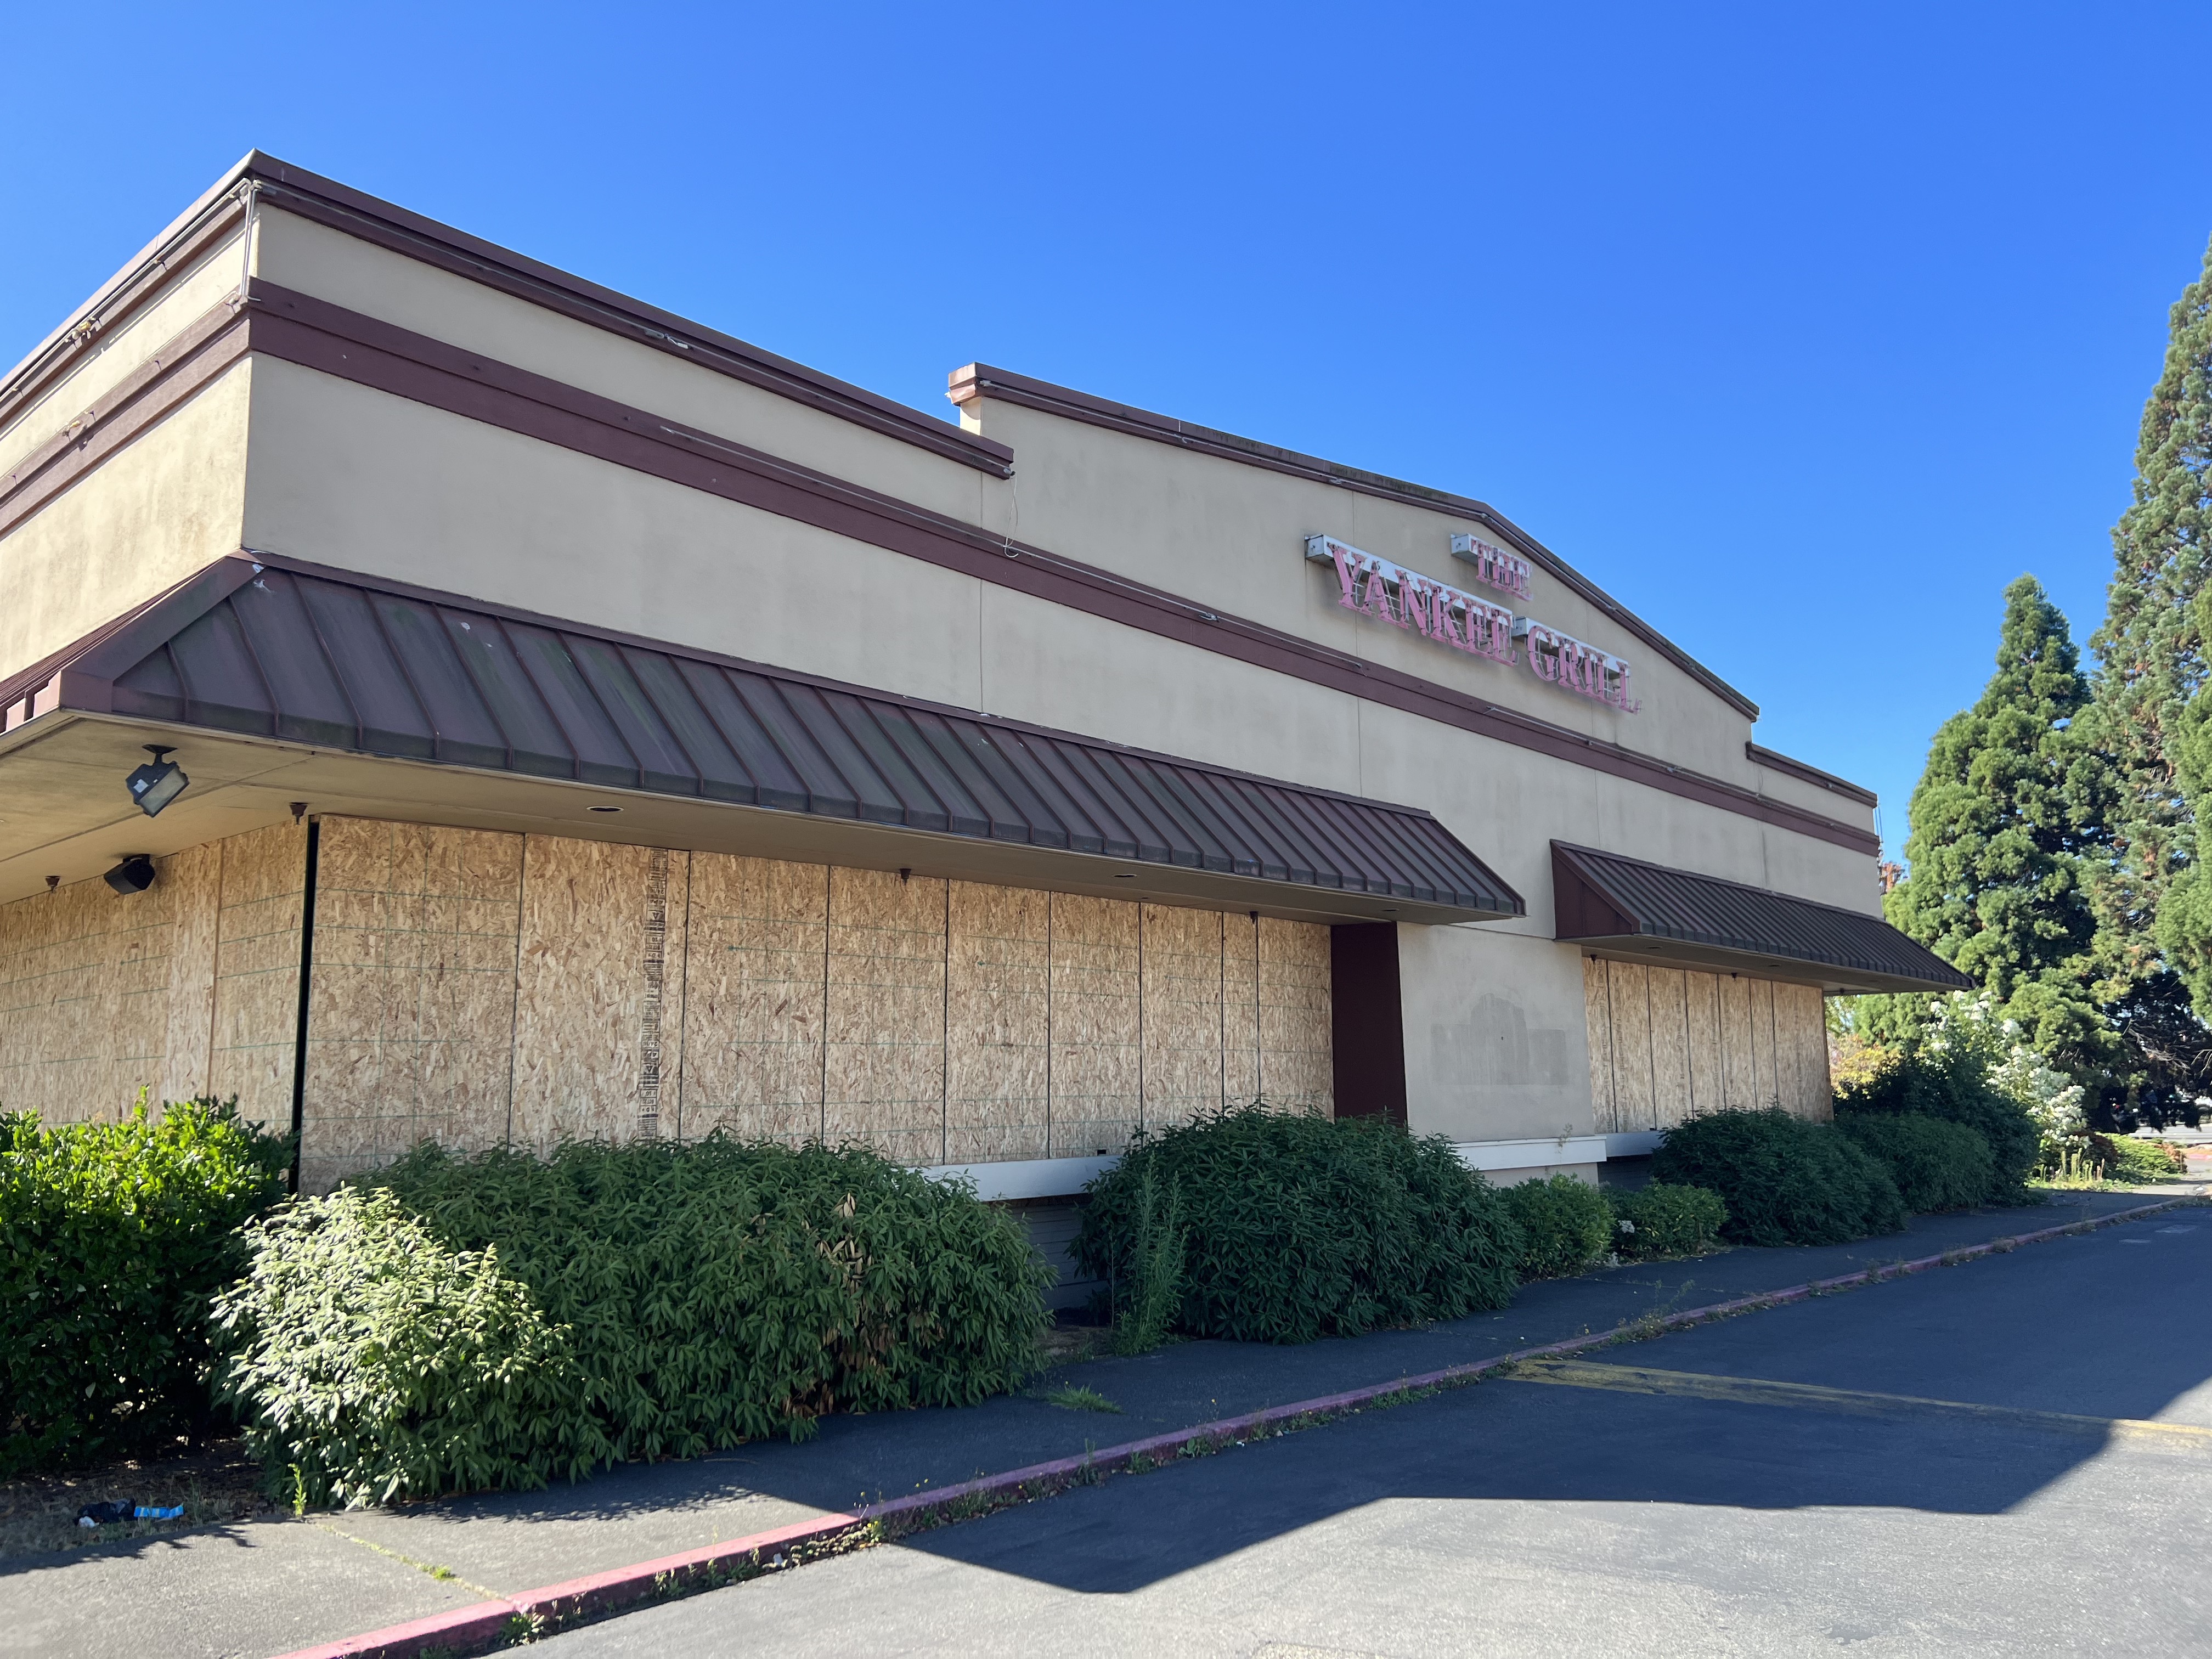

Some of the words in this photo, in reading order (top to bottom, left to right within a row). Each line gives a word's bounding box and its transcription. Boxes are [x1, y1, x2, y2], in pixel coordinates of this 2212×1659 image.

[1327, 541, 1519, 667] YANKEE
[1527, 625, 1642, 715] GRILL
[1471, 538, 1532, 601] THE
